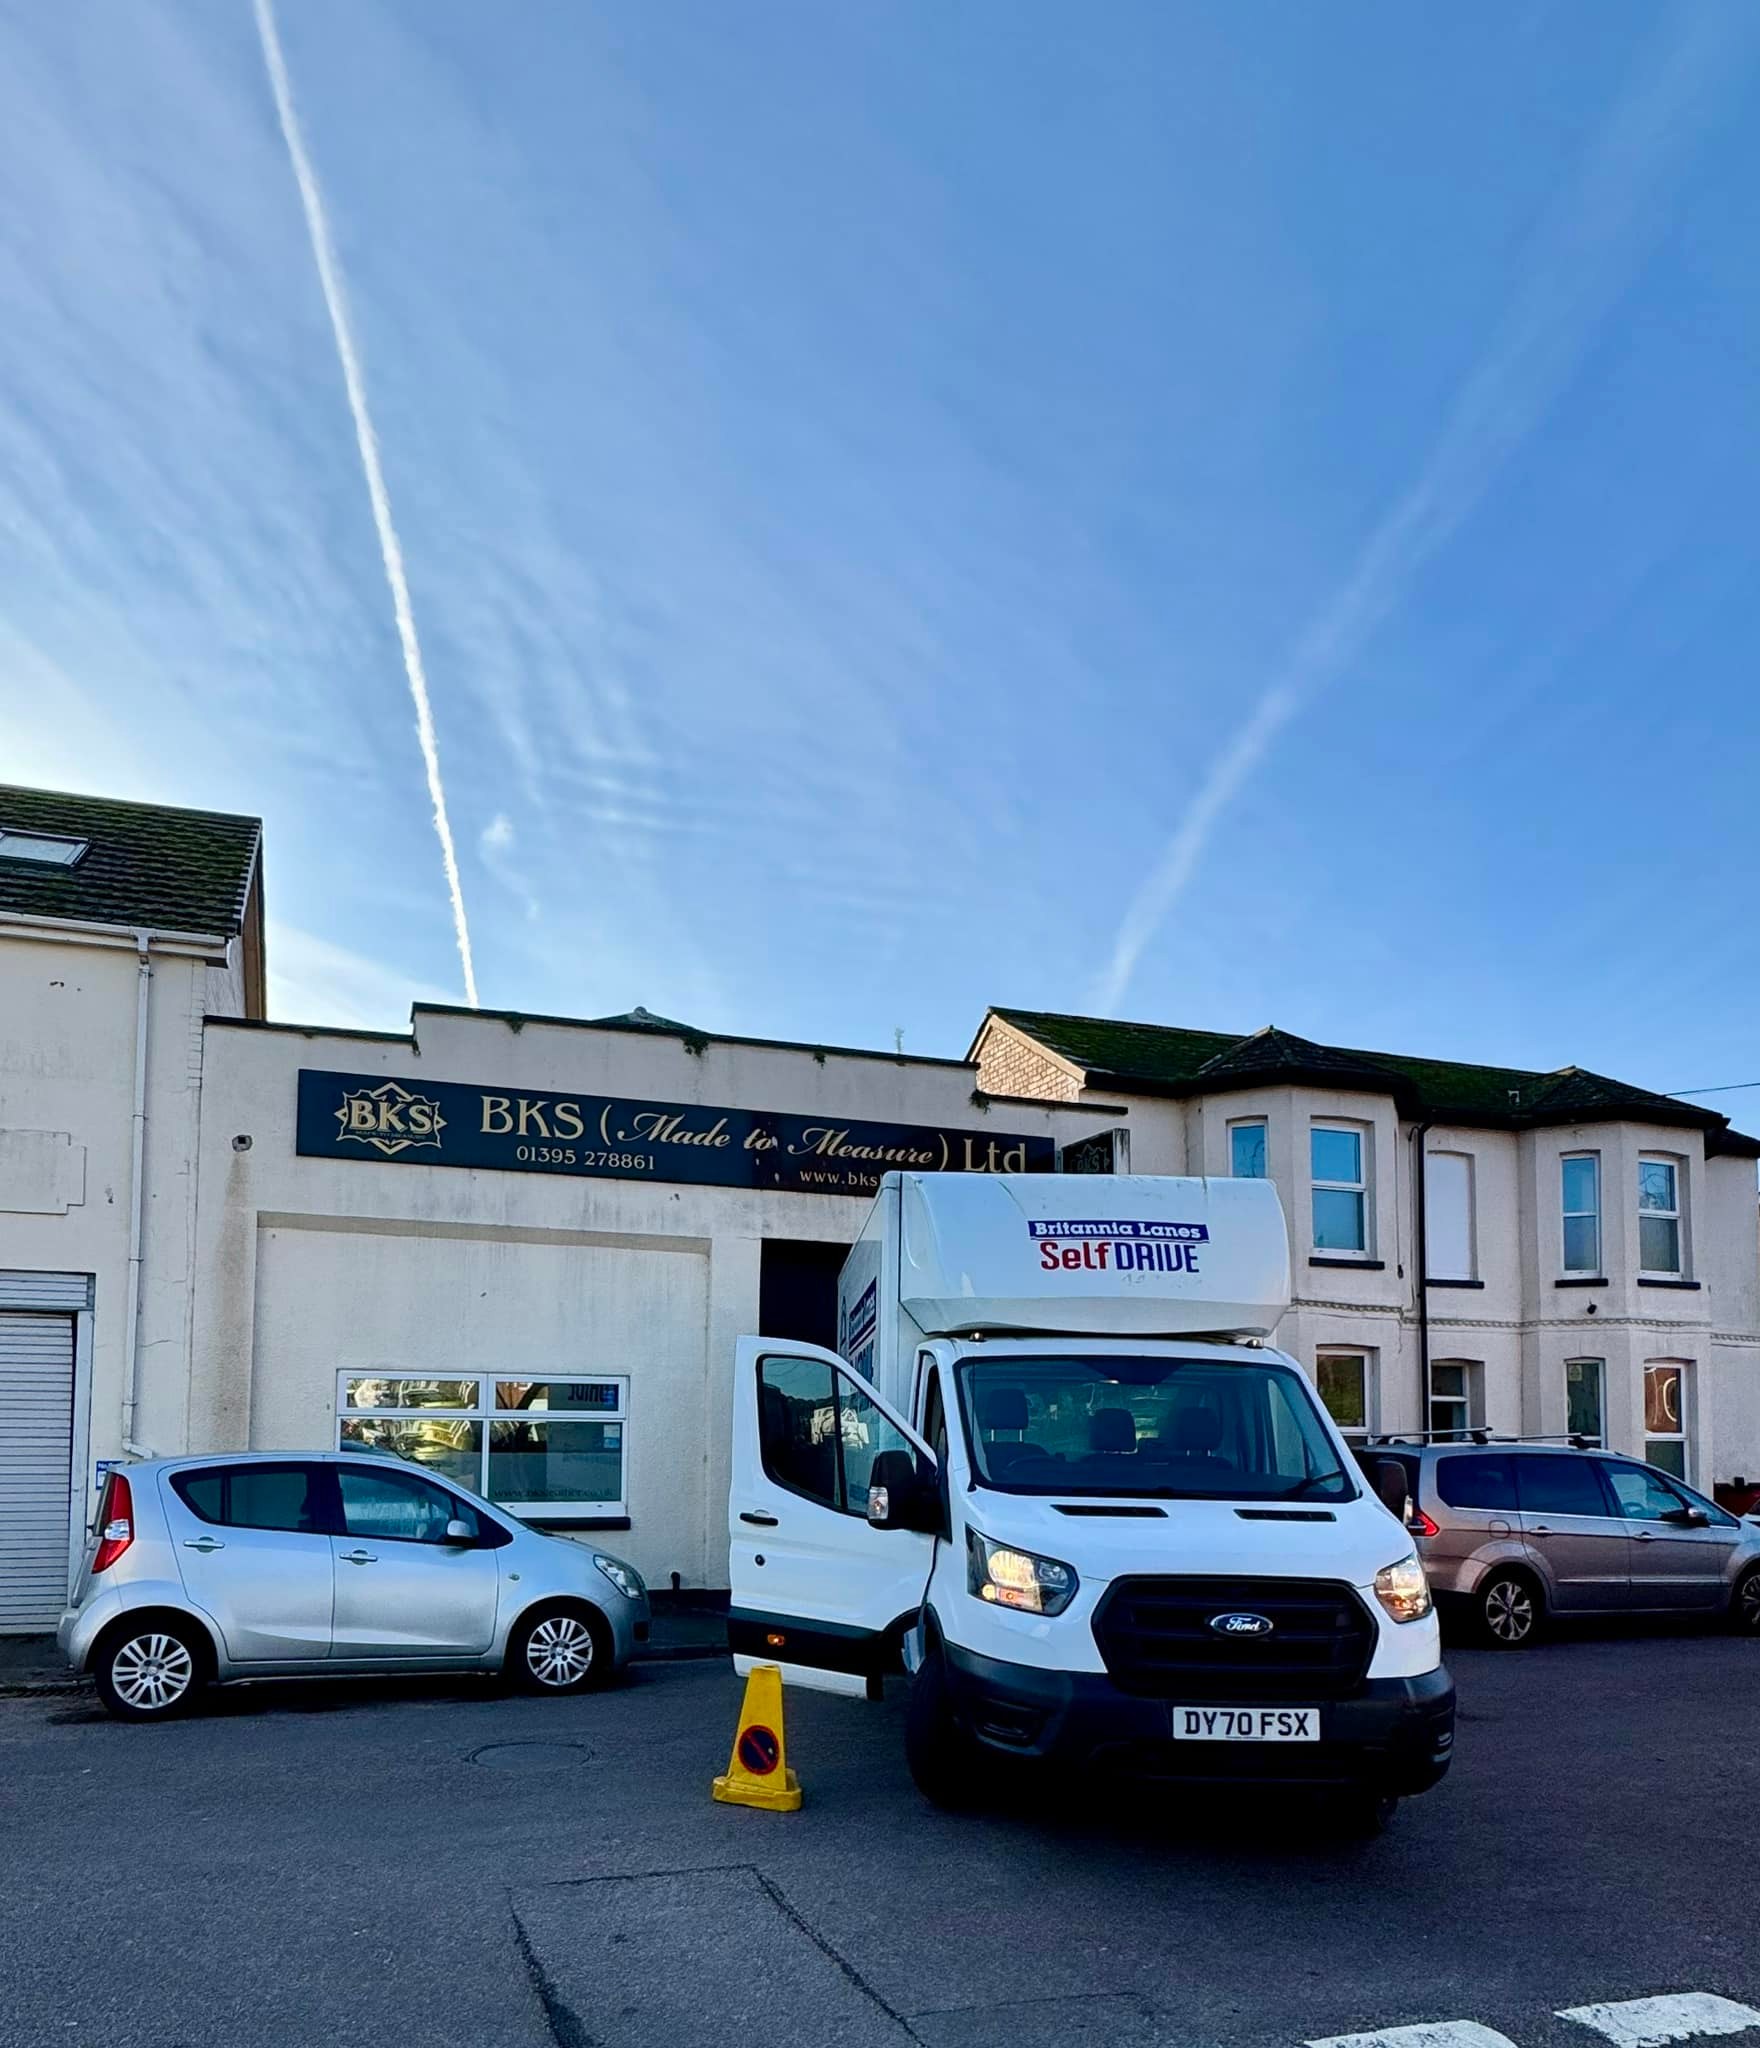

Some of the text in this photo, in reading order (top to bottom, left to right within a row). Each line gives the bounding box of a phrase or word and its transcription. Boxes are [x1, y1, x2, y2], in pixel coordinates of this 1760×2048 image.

[349, 1099, 433, 1135] BKS
[479, 1095, 585, 1140] BKS
[743, 1128, 773, 1150] to
[963, 1138, 1027, 1173] Ltd
[516, 1145, 655, 1170] 01395 278861
[1035, 1222, 1201, 1239] Britannia Lanes
[1226, 1616, 1261, 1631] Ford
[1185, 1711, 1309, 1736] DY70 FSX
